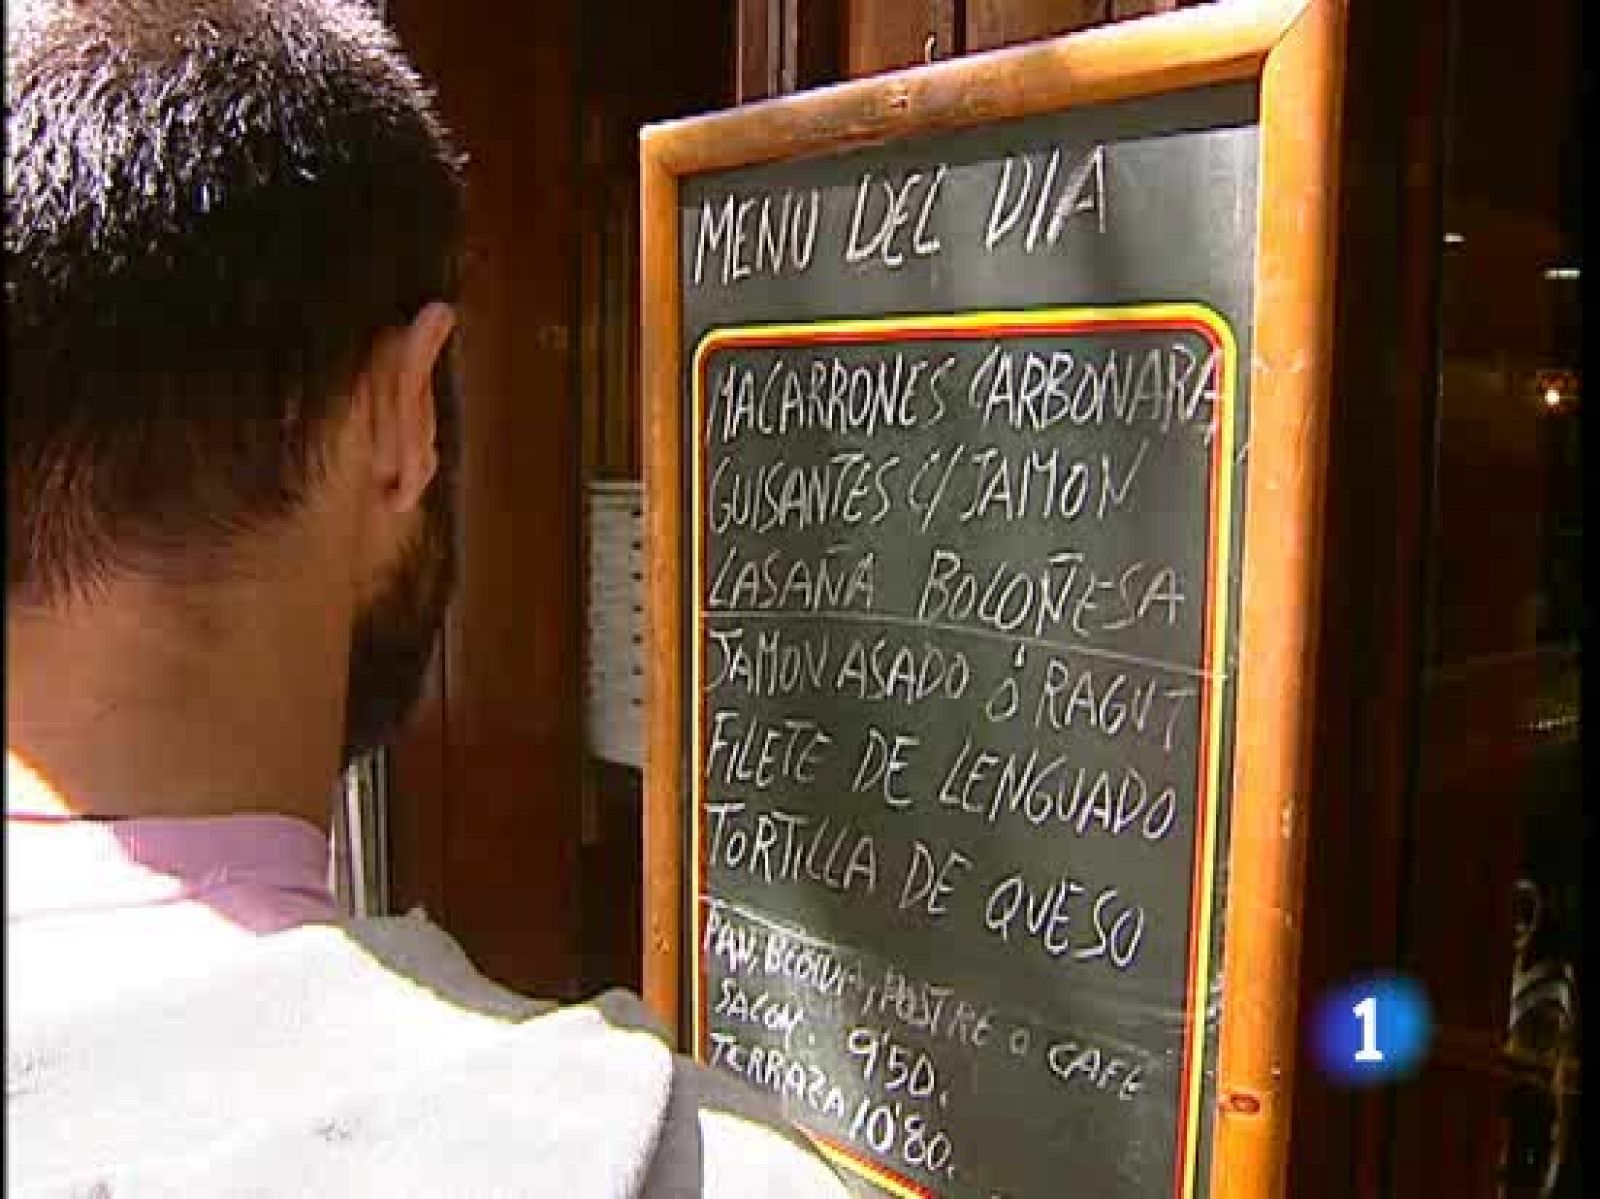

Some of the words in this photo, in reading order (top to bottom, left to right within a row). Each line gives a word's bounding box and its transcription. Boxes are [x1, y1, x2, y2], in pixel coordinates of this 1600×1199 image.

[694, 191, 820, 285] MENU
[845, 163, 949, 266] DEL
[985, 144, 1106, 253] DIA
[705, 352, 957, 444] MACARRONES
[968, 343, 1221, 446] CARBONARA
[709, 453, 900, 533] GUISANTES
[959, 440, 1148, 522] JAMON
[709, 543, 878, 613] LASAÑA
[918, 549, 1185, 638] BOLOÑESA
[705, 629, 829, 698] JAMON
[836, 640, 970, 704] ASADO
[1035, 657, 1197, 750] RAGUT
[706, 710, 832, 789] FILETE
[852, 727, 919, 805] DE
[938, 737, 1177, 840] LENGUADO
[706, 802, 879, 893] TORTILLA
[899, 841, 974, 914] DE
[984, 869, 1145, 967] QUESO
[709, 1032, 845, 1119] TERRAZA
